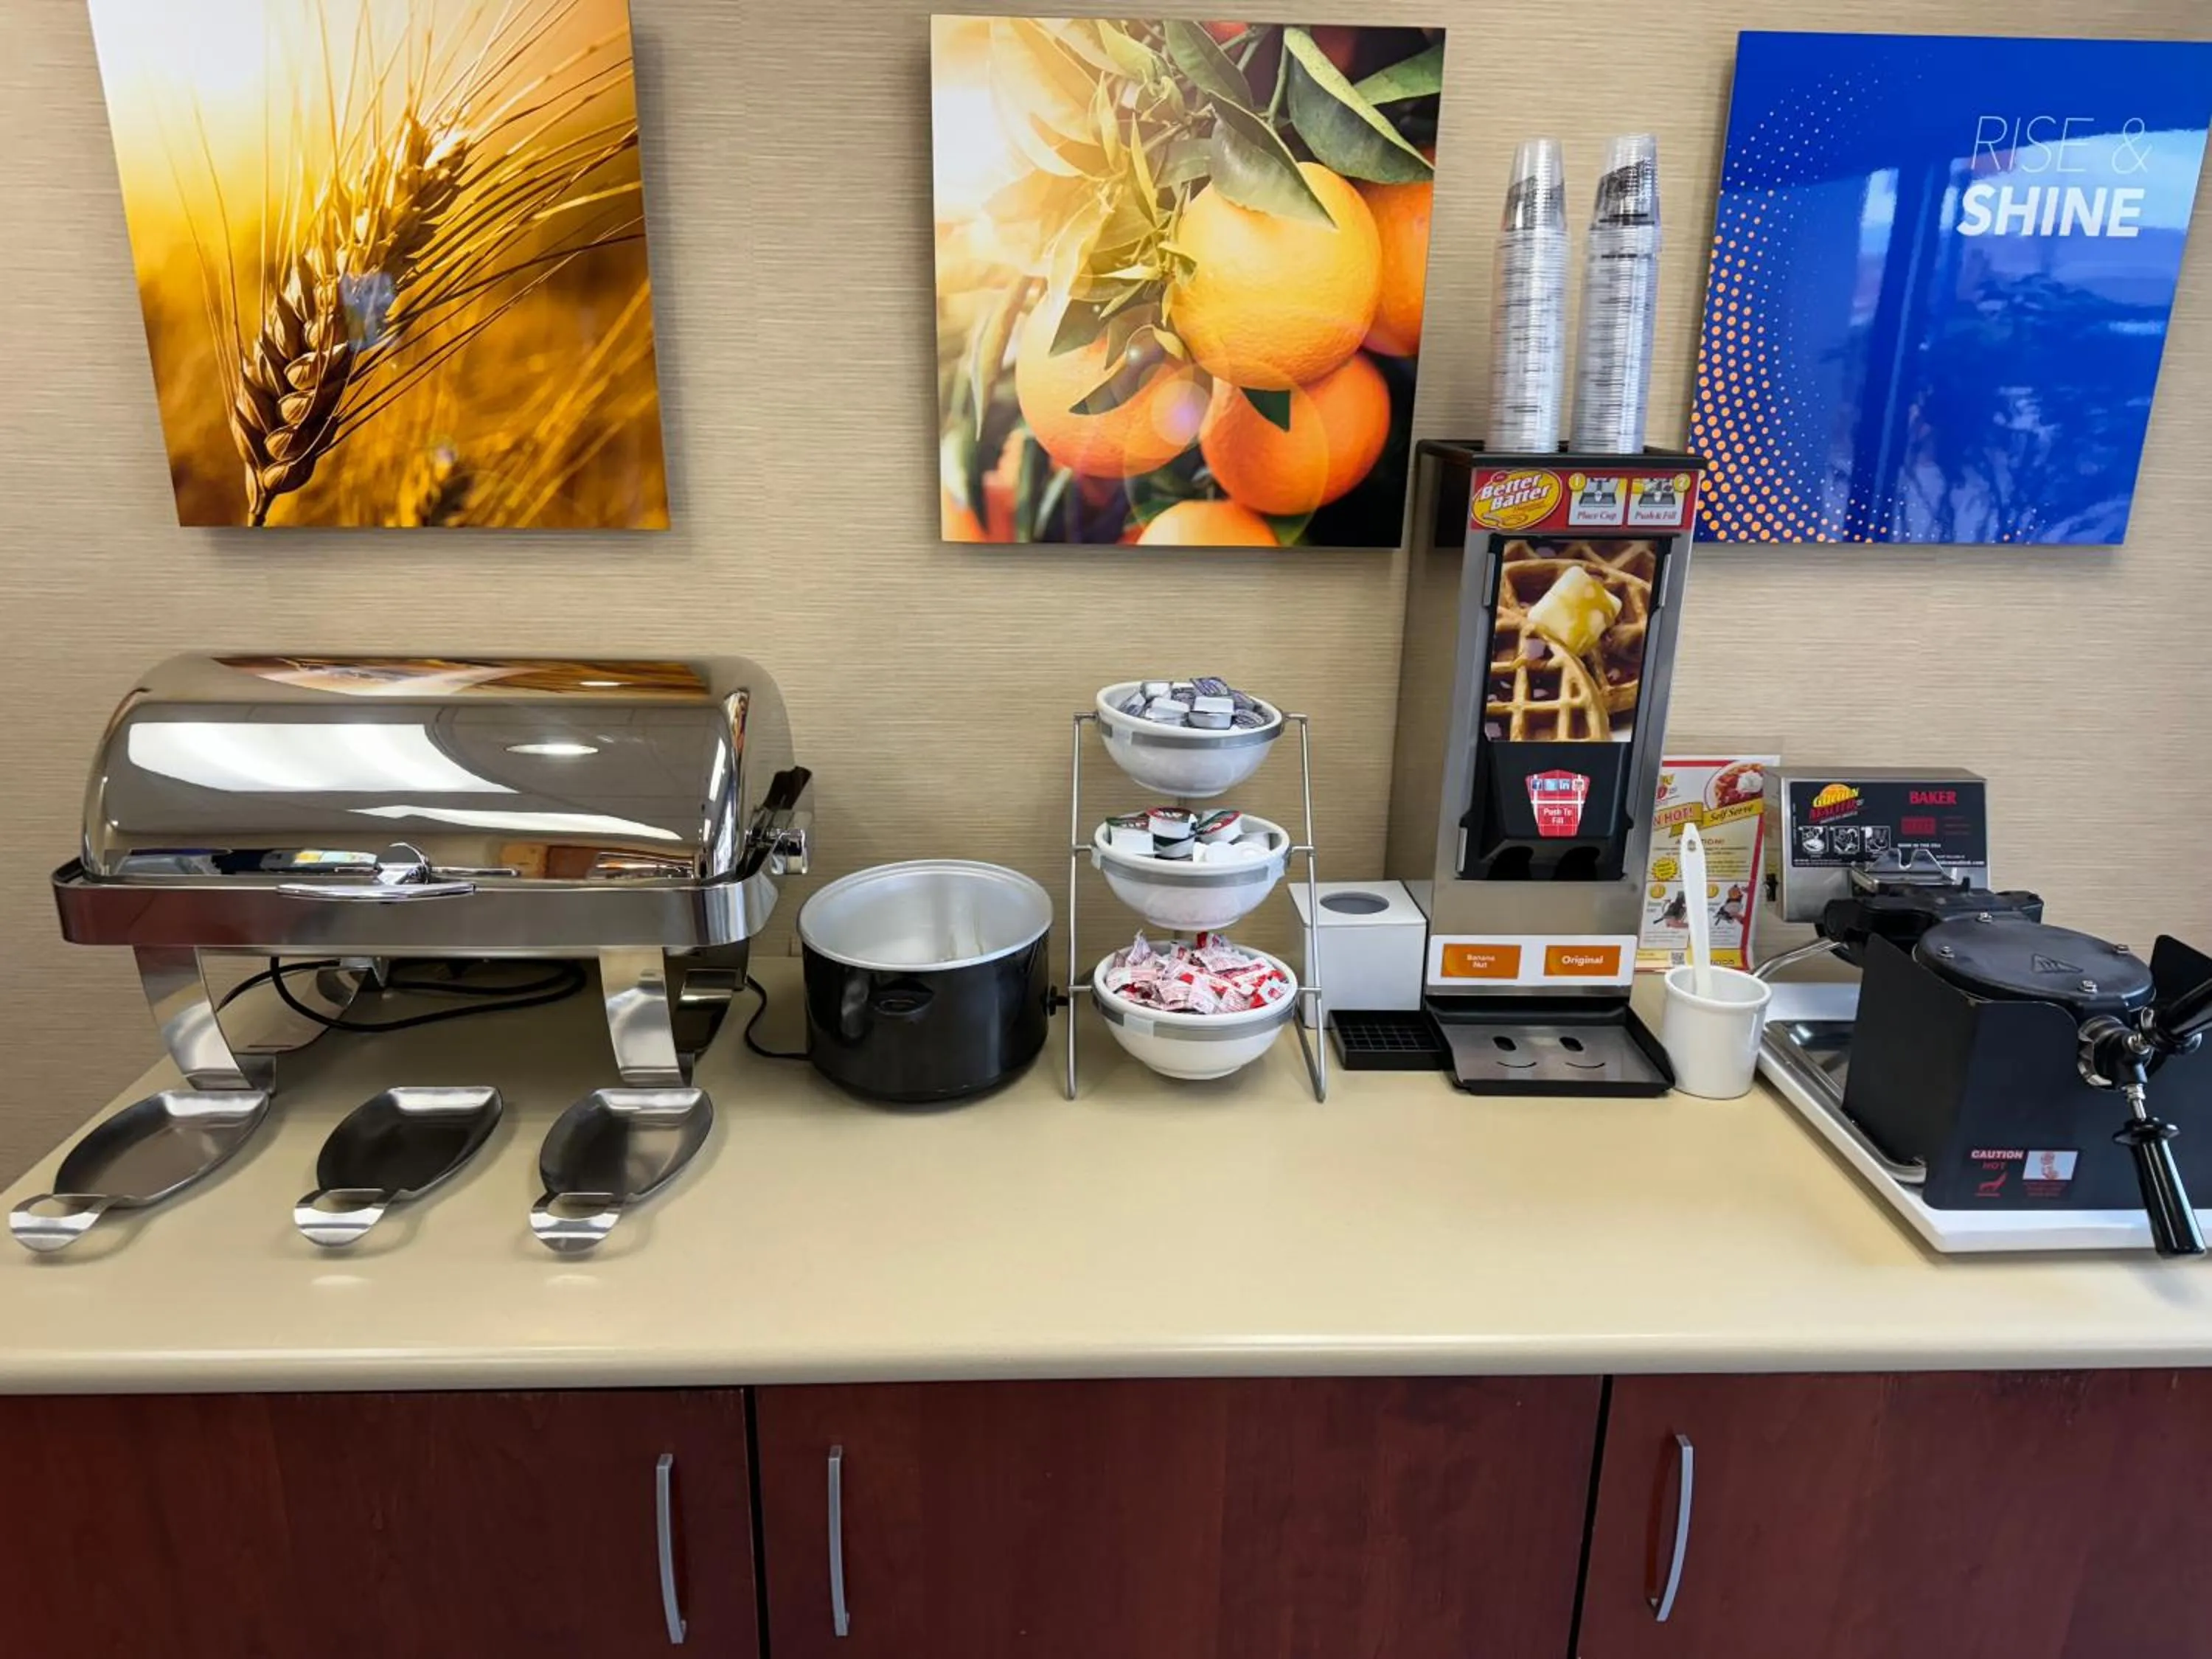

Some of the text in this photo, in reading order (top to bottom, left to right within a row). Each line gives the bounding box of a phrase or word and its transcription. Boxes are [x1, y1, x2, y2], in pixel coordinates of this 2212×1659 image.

[1971, 116, 2152, 174] RISE &
[1956, 184, 2144, 237] SHINE
[1481, 474, 1542, 500] Better
[1491, 484, 1551, 512] Batter
[1577, 510, 1617, 521] Place Cup
[1910, 790, 1957, 805] BAKER
[1664, 807, 1693, 824] HOT!
[1466, 953, 1495, 961] Banana
[1561, 955, 1604, 967] Original
[1971, 1150, 2024, 1160] CAUTION
[1982, 1162, 2006, 1170] HOT
